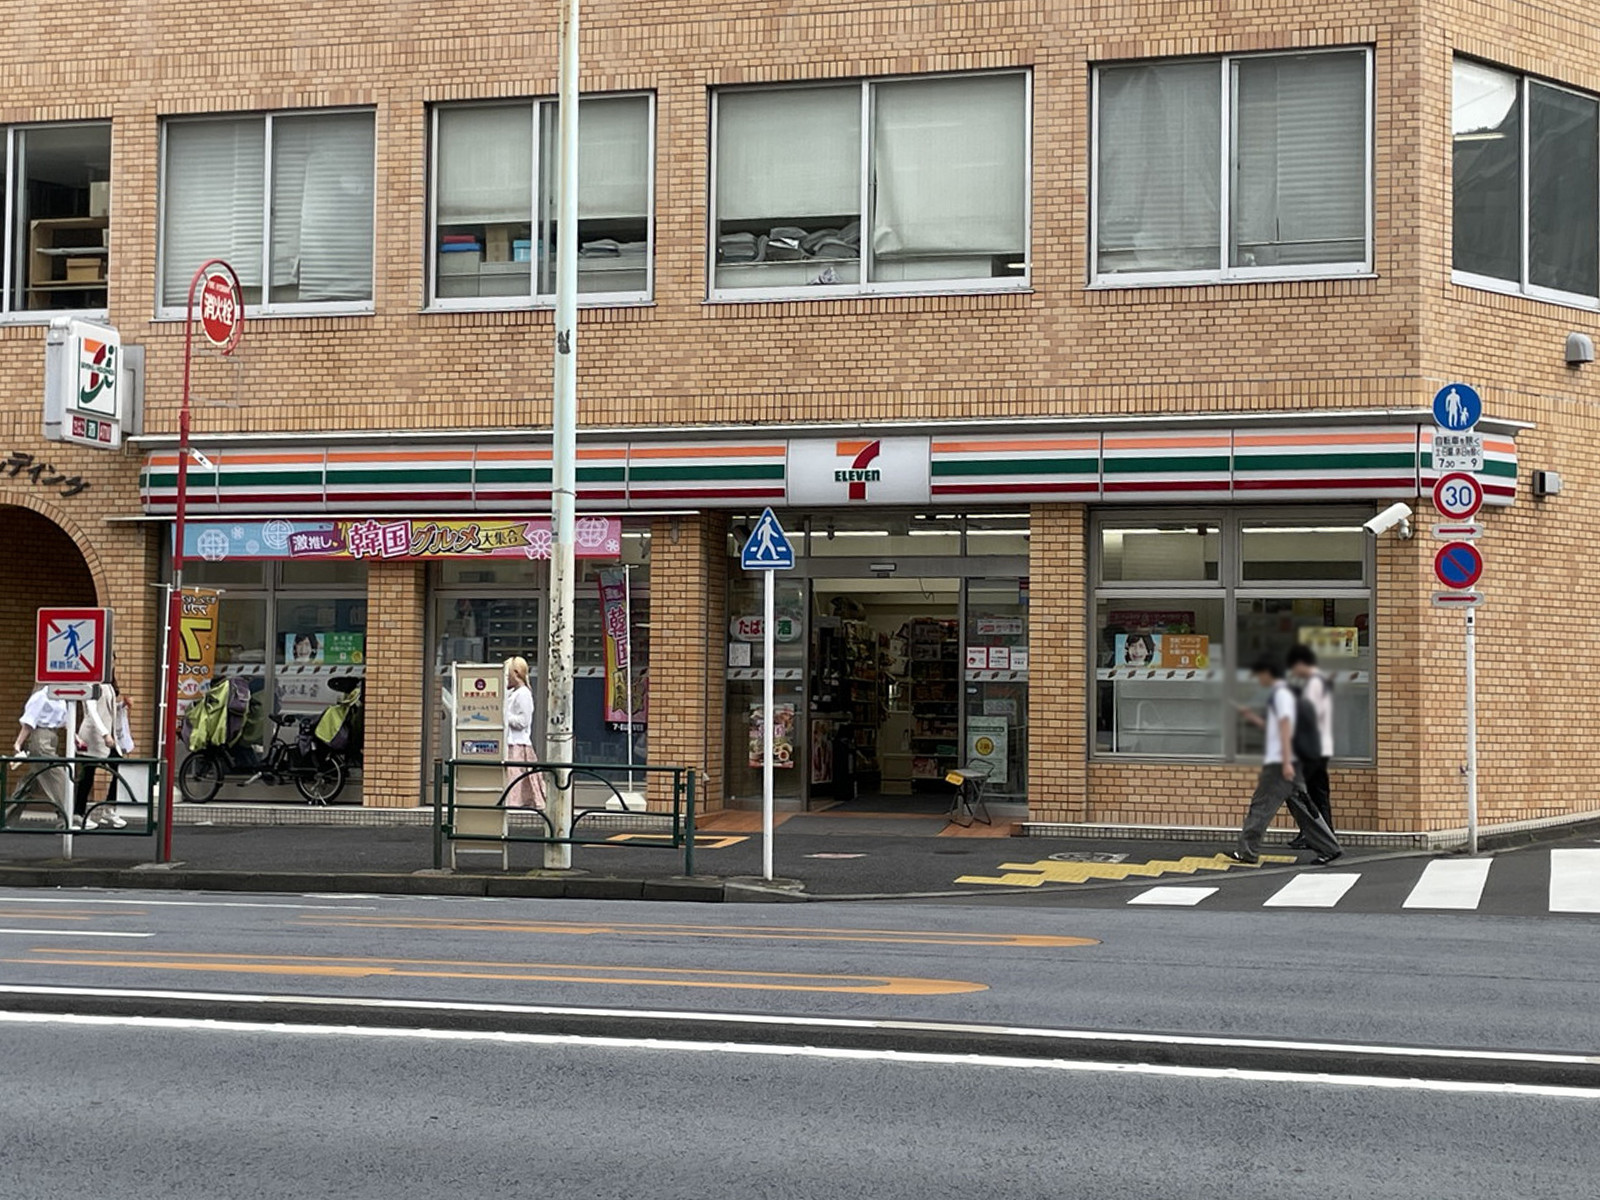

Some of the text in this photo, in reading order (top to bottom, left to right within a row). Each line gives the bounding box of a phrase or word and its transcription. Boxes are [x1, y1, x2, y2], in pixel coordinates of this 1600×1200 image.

[203, 291, 233, 326] 消火栓
[1445, 486, 1473, 507] 30
[738, 620, 767, 635] たば
[777, 620, 792, 635] 酒
